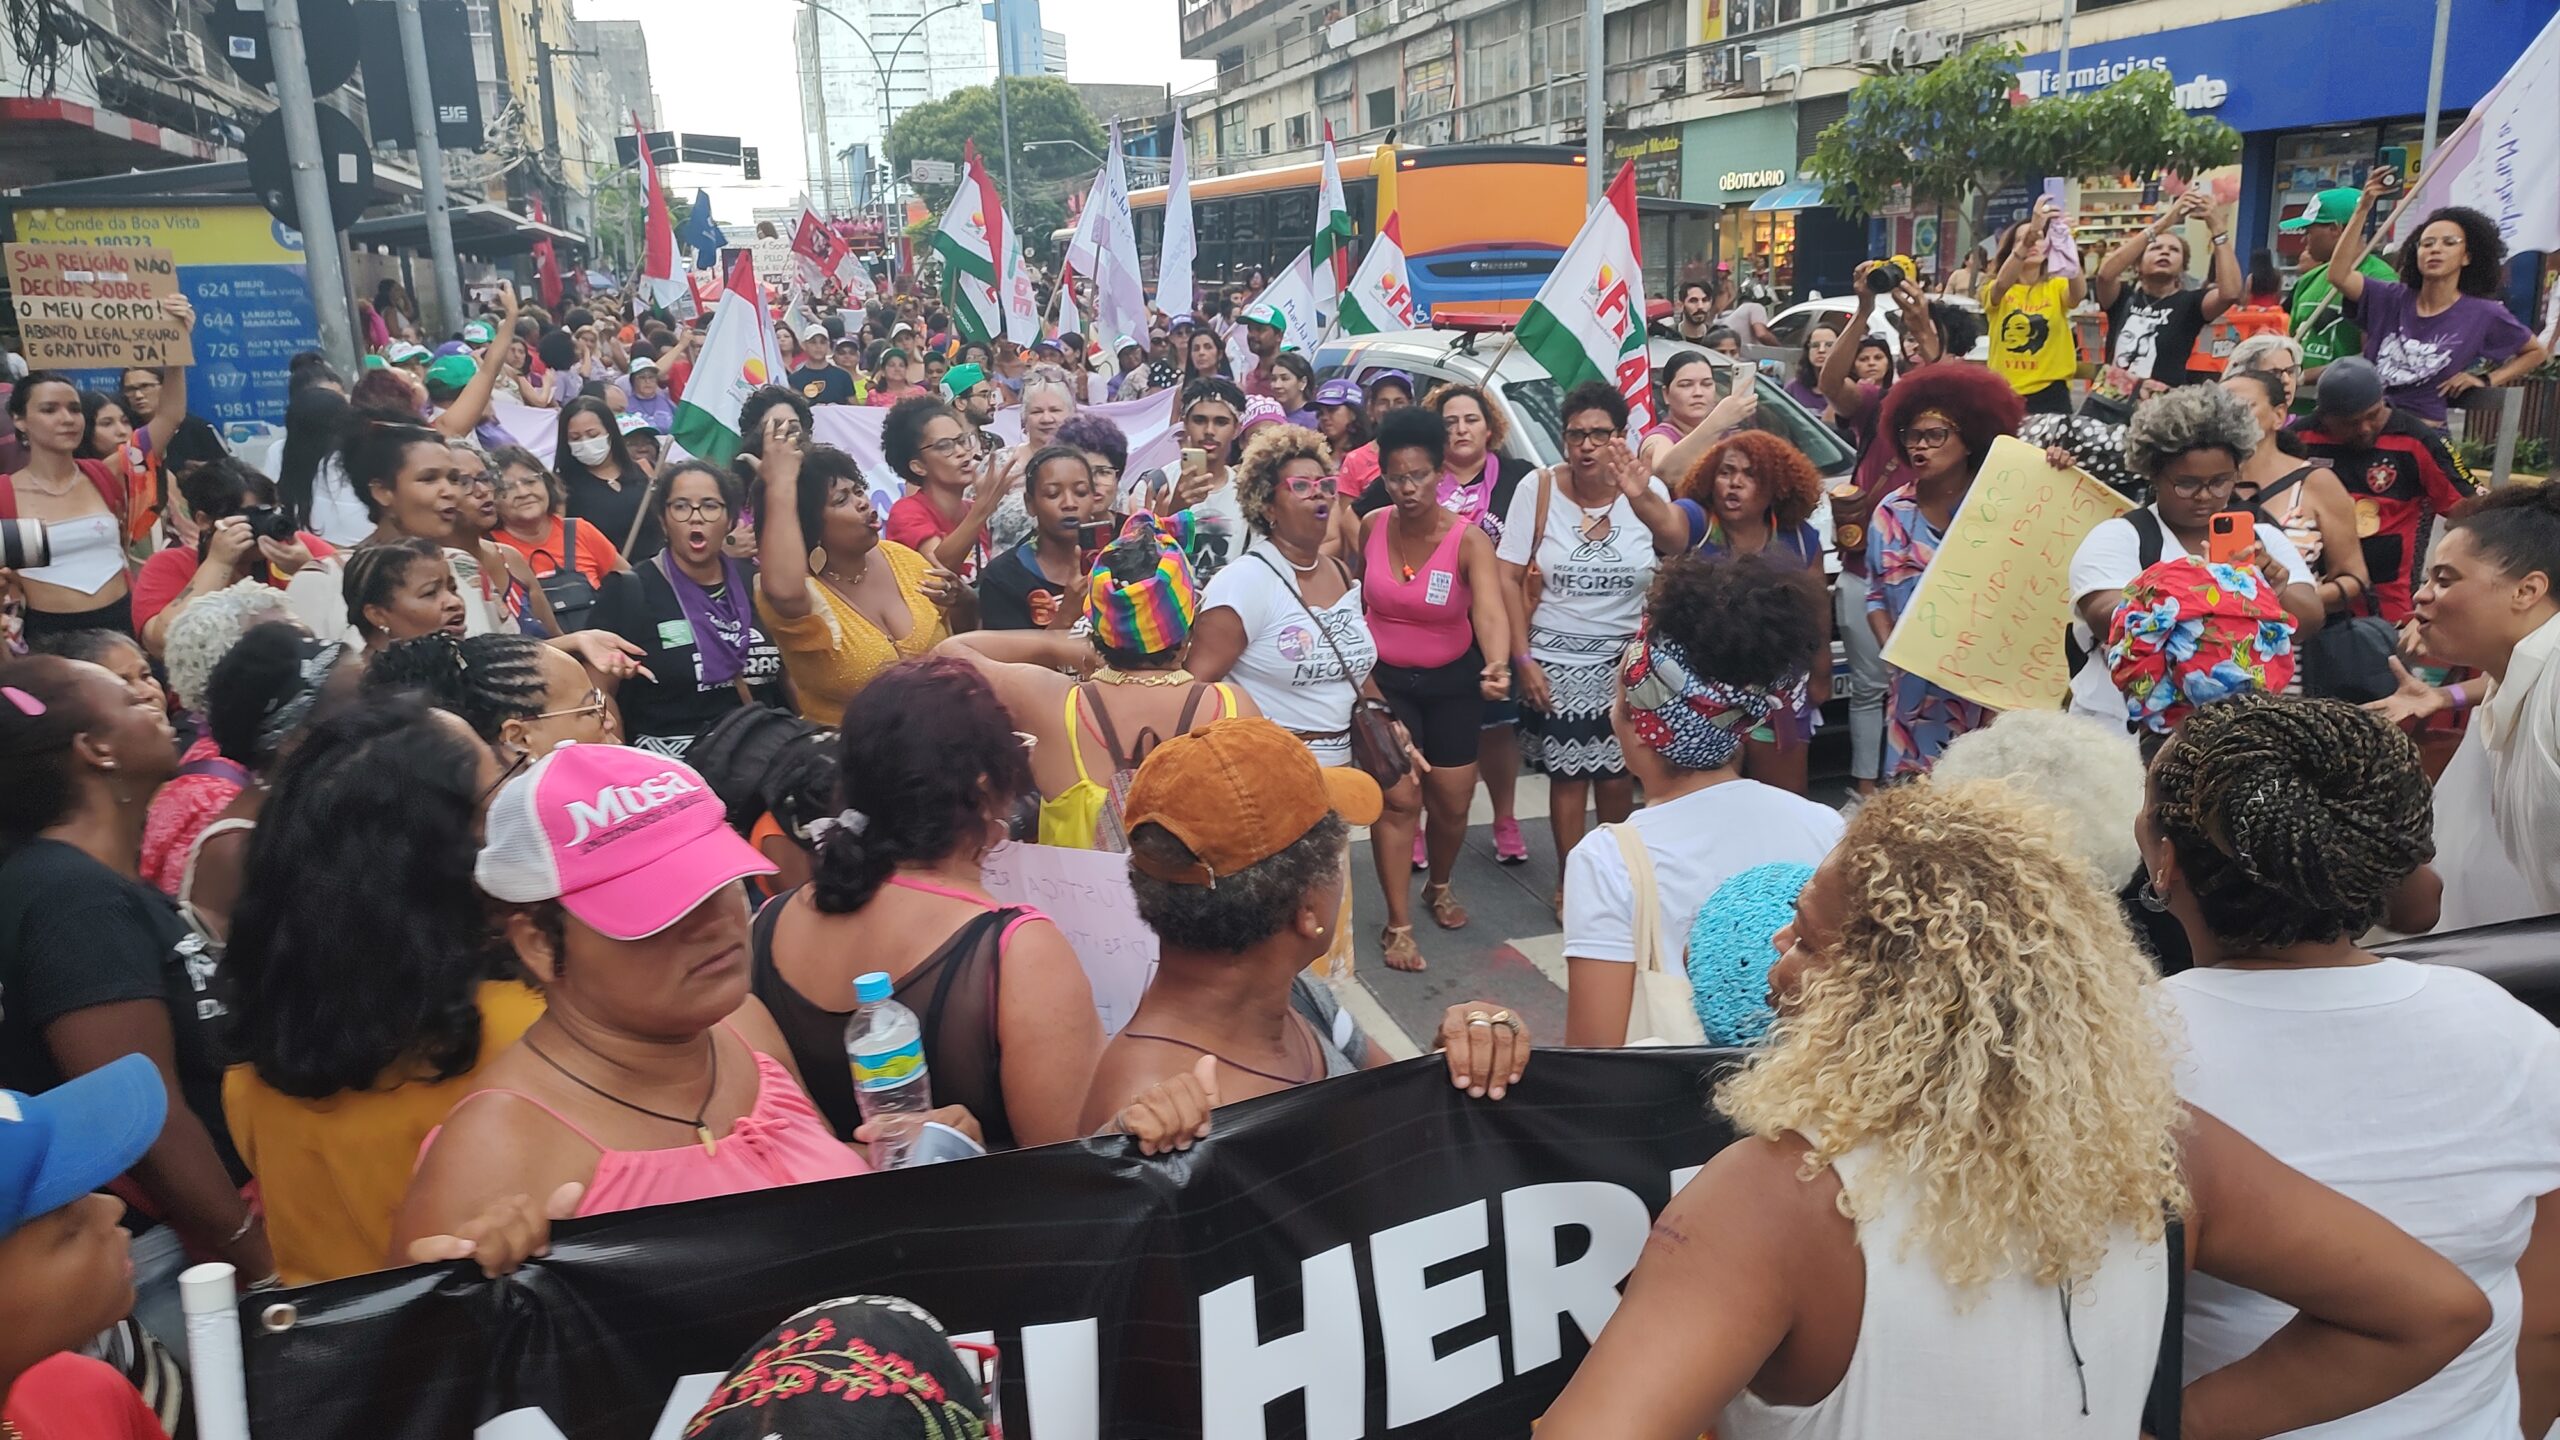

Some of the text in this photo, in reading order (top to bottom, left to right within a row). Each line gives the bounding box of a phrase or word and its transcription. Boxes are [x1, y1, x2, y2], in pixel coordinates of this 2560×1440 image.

[55, 216, 104, 231] Conde
[109, 215, 126, 230] da
[132, 215, 160, 230] Boa
[164, 214, 201, 230] Vista
[15, 251, 49, 272] SUA
[20, 277, 153, 300] DECIDE SOBRE
[198, 282, 230, 299] 624
[20, 299, 162, 320] O MEU CORPO!
[203, 312, 234, 328] 644
[25, 324, 77, 340] ABORTO
[29, 343, 38, 357] E
[43, 342, 121, 358] GRATUITO
[207, 343, 240, 358] 726
[2005, 361, 2038, 370] VIVE
[208, 372, 247, 389] 1977
[214, 403, 253, 418] 1981
[1962, 468, 2027, 549] 2023
[2009, 485, 2053, 547] ISSO
[1552, 573, 1635, 590] NEGRAS
[564, 771, 702, 849] Musa
